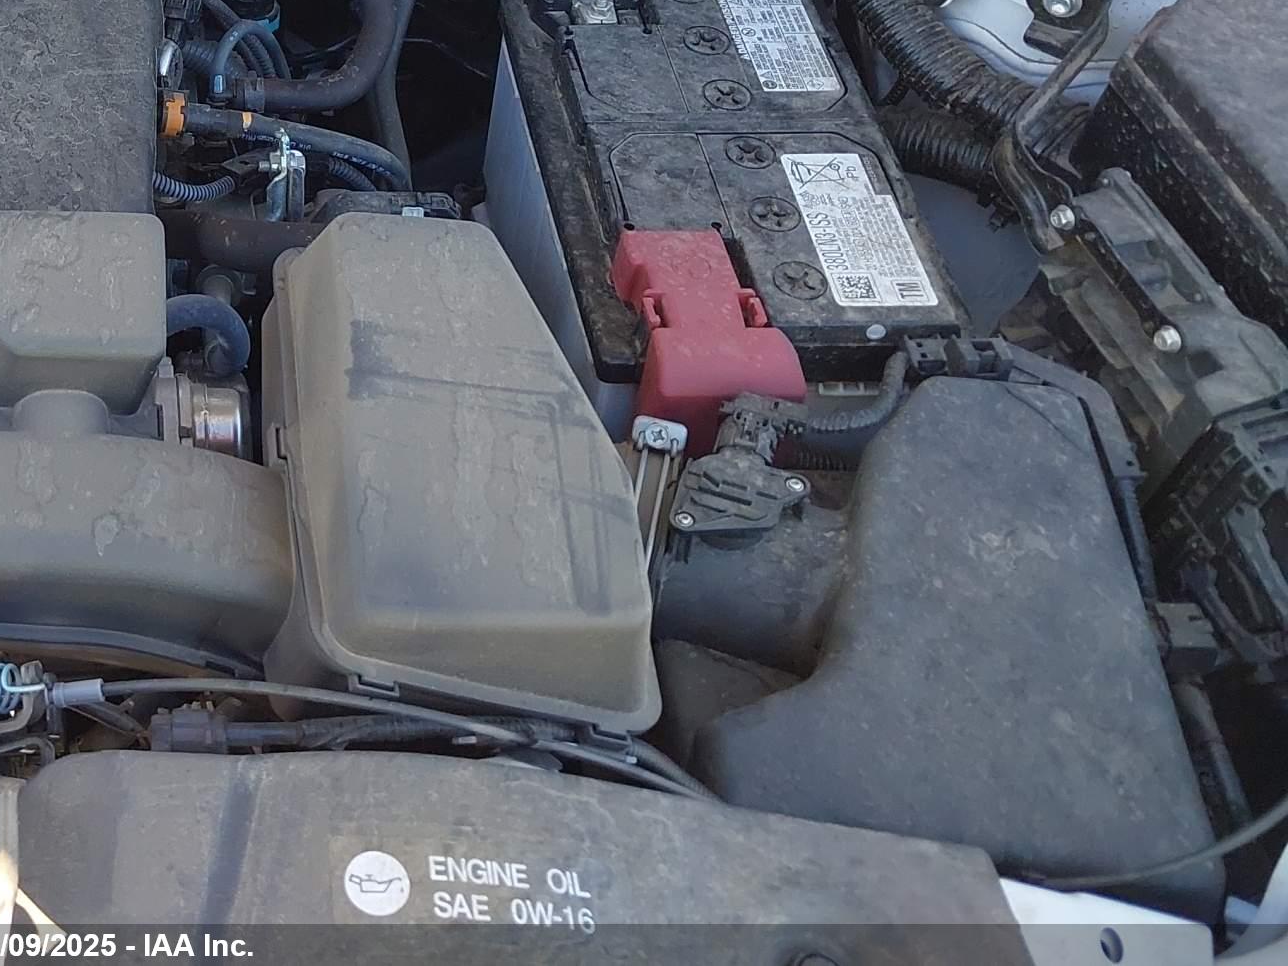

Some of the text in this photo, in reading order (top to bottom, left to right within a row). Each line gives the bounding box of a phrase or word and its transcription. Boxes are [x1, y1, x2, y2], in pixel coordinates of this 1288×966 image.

[844, 165, 860, 179] Pb
[895, 282, 924, 299] TM
[428, 855, 592, 898] ENGINE OIL
[433, 891, 597, 935] SAE 0W-16
